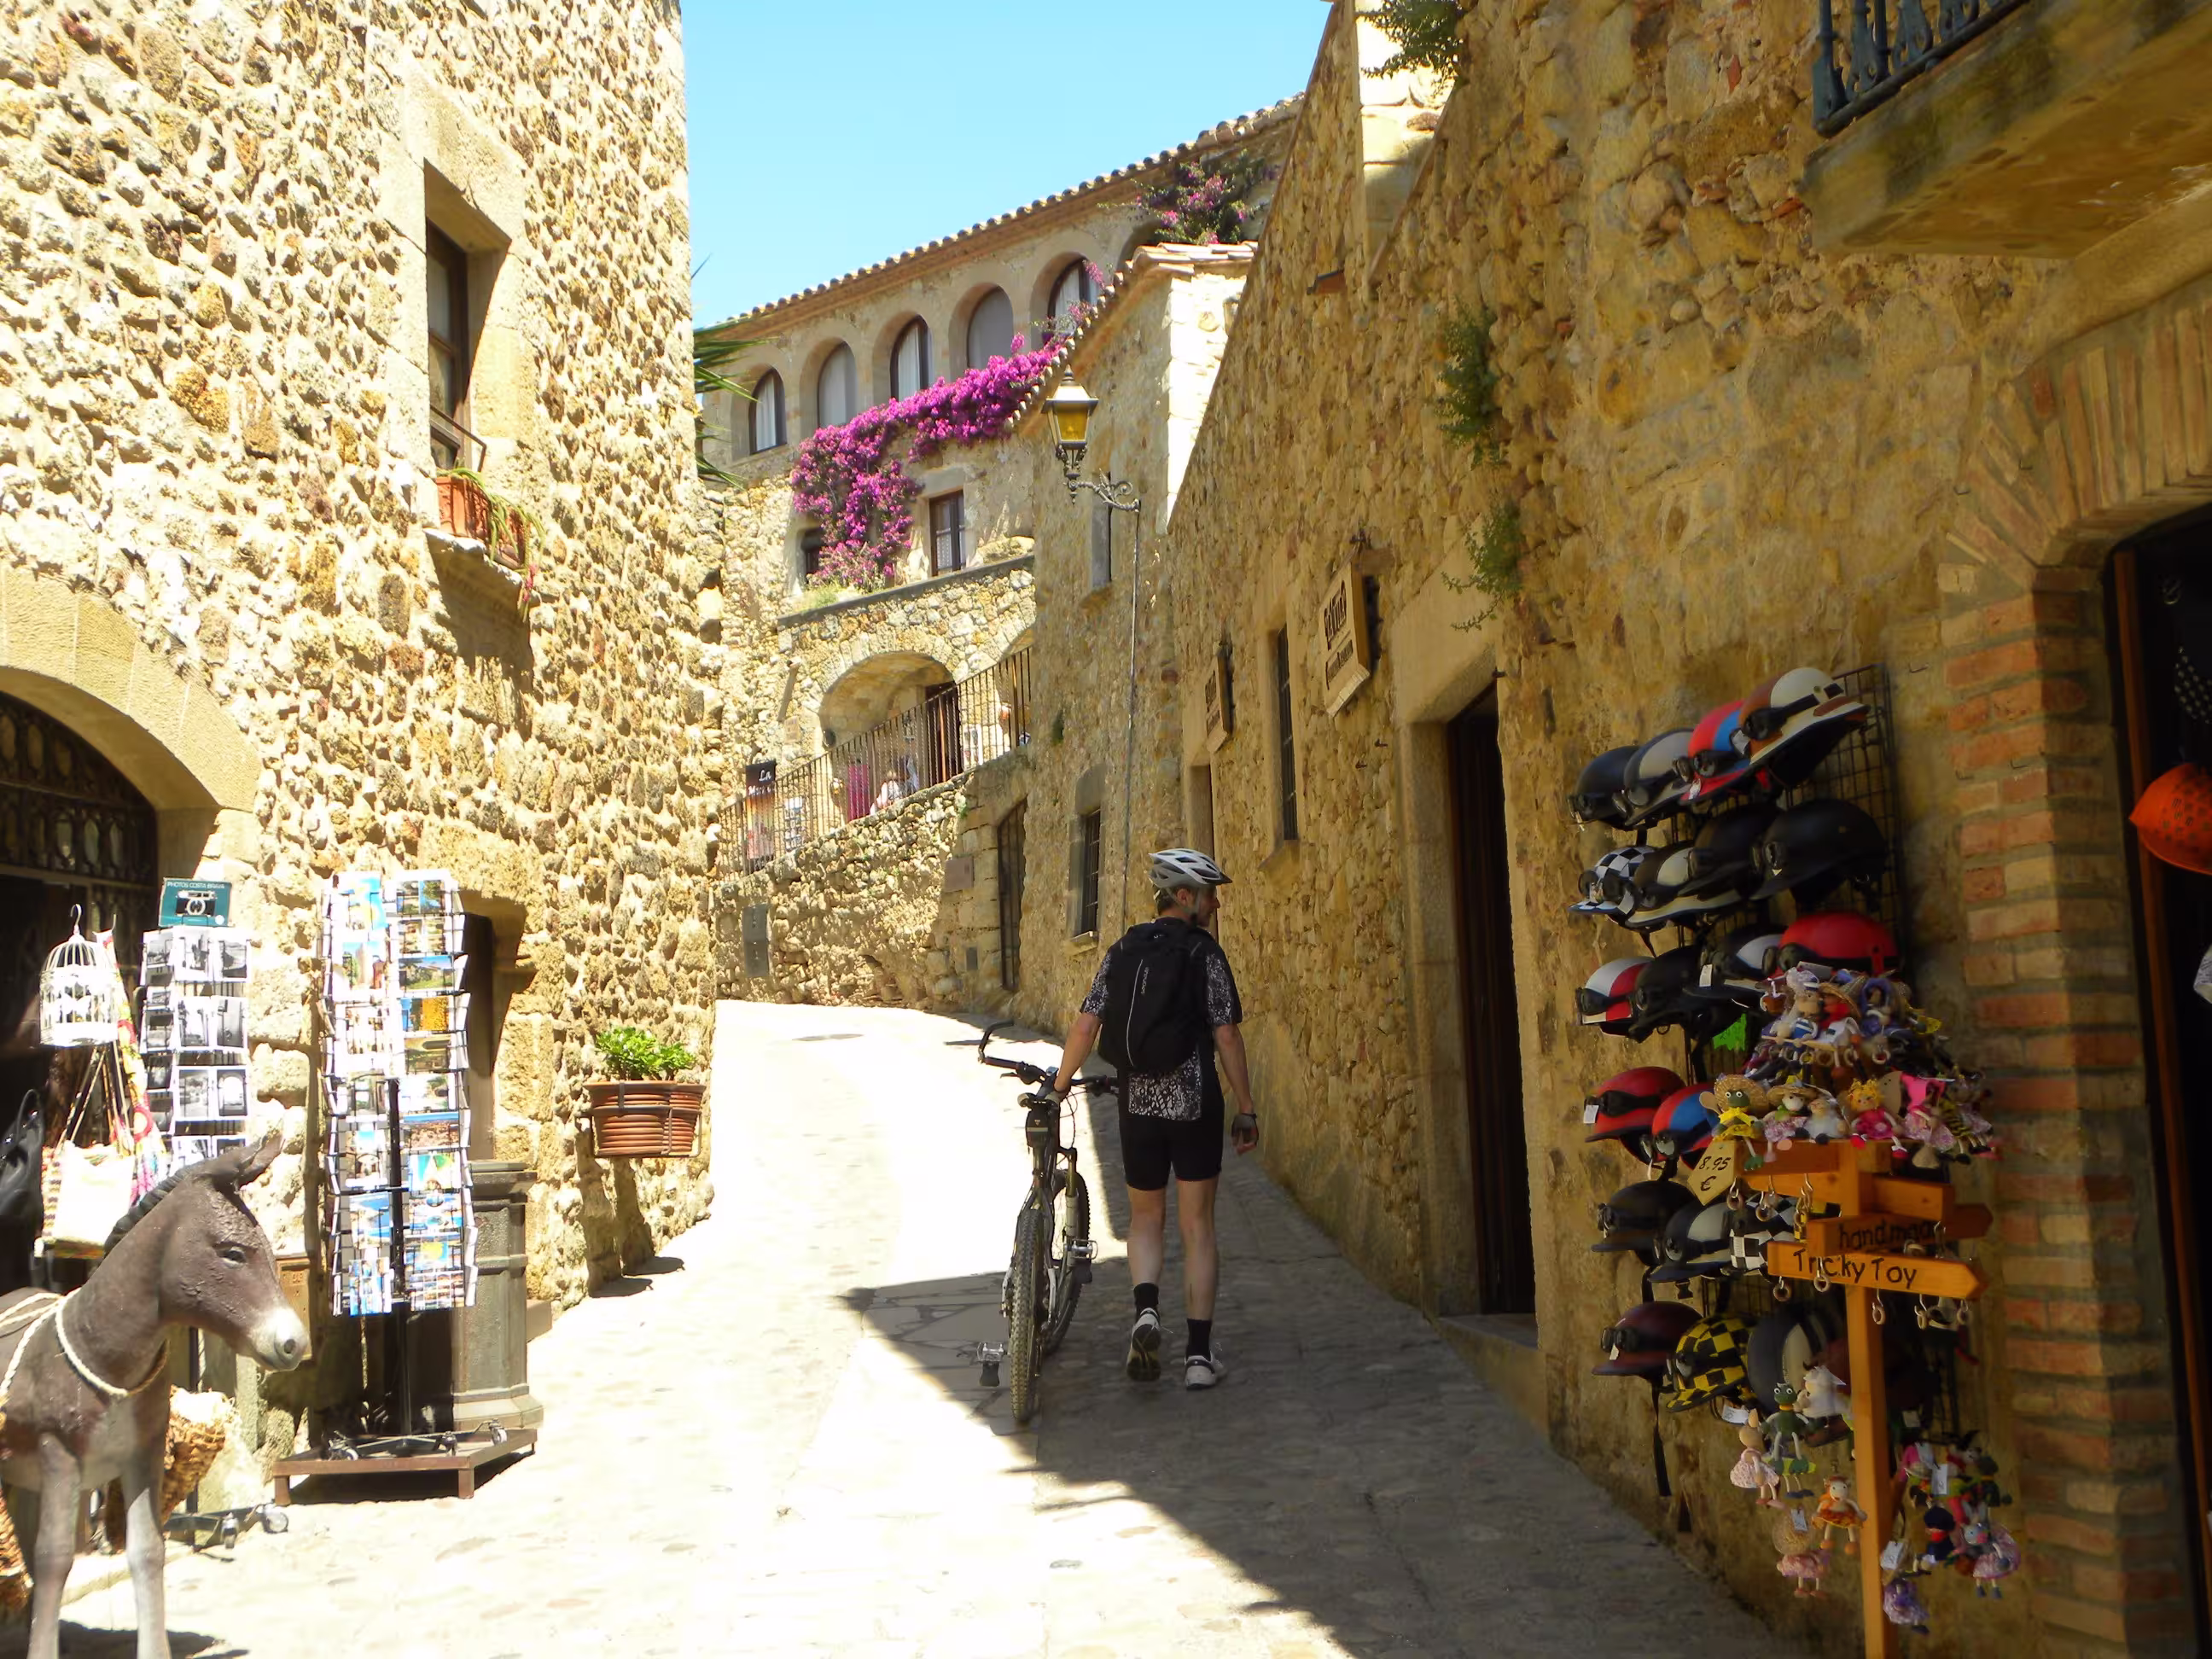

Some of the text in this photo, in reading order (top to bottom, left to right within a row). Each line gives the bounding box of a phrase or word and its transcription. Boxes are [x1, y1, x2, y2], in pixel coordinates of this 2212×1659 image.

[759, 769, 771, 782] La
[1699, 1155, 1732, 1171] 8.95
[1700, 1175, 1717, 1192] €
[1793, 1248, 1918, 1289] Tricky Toy
